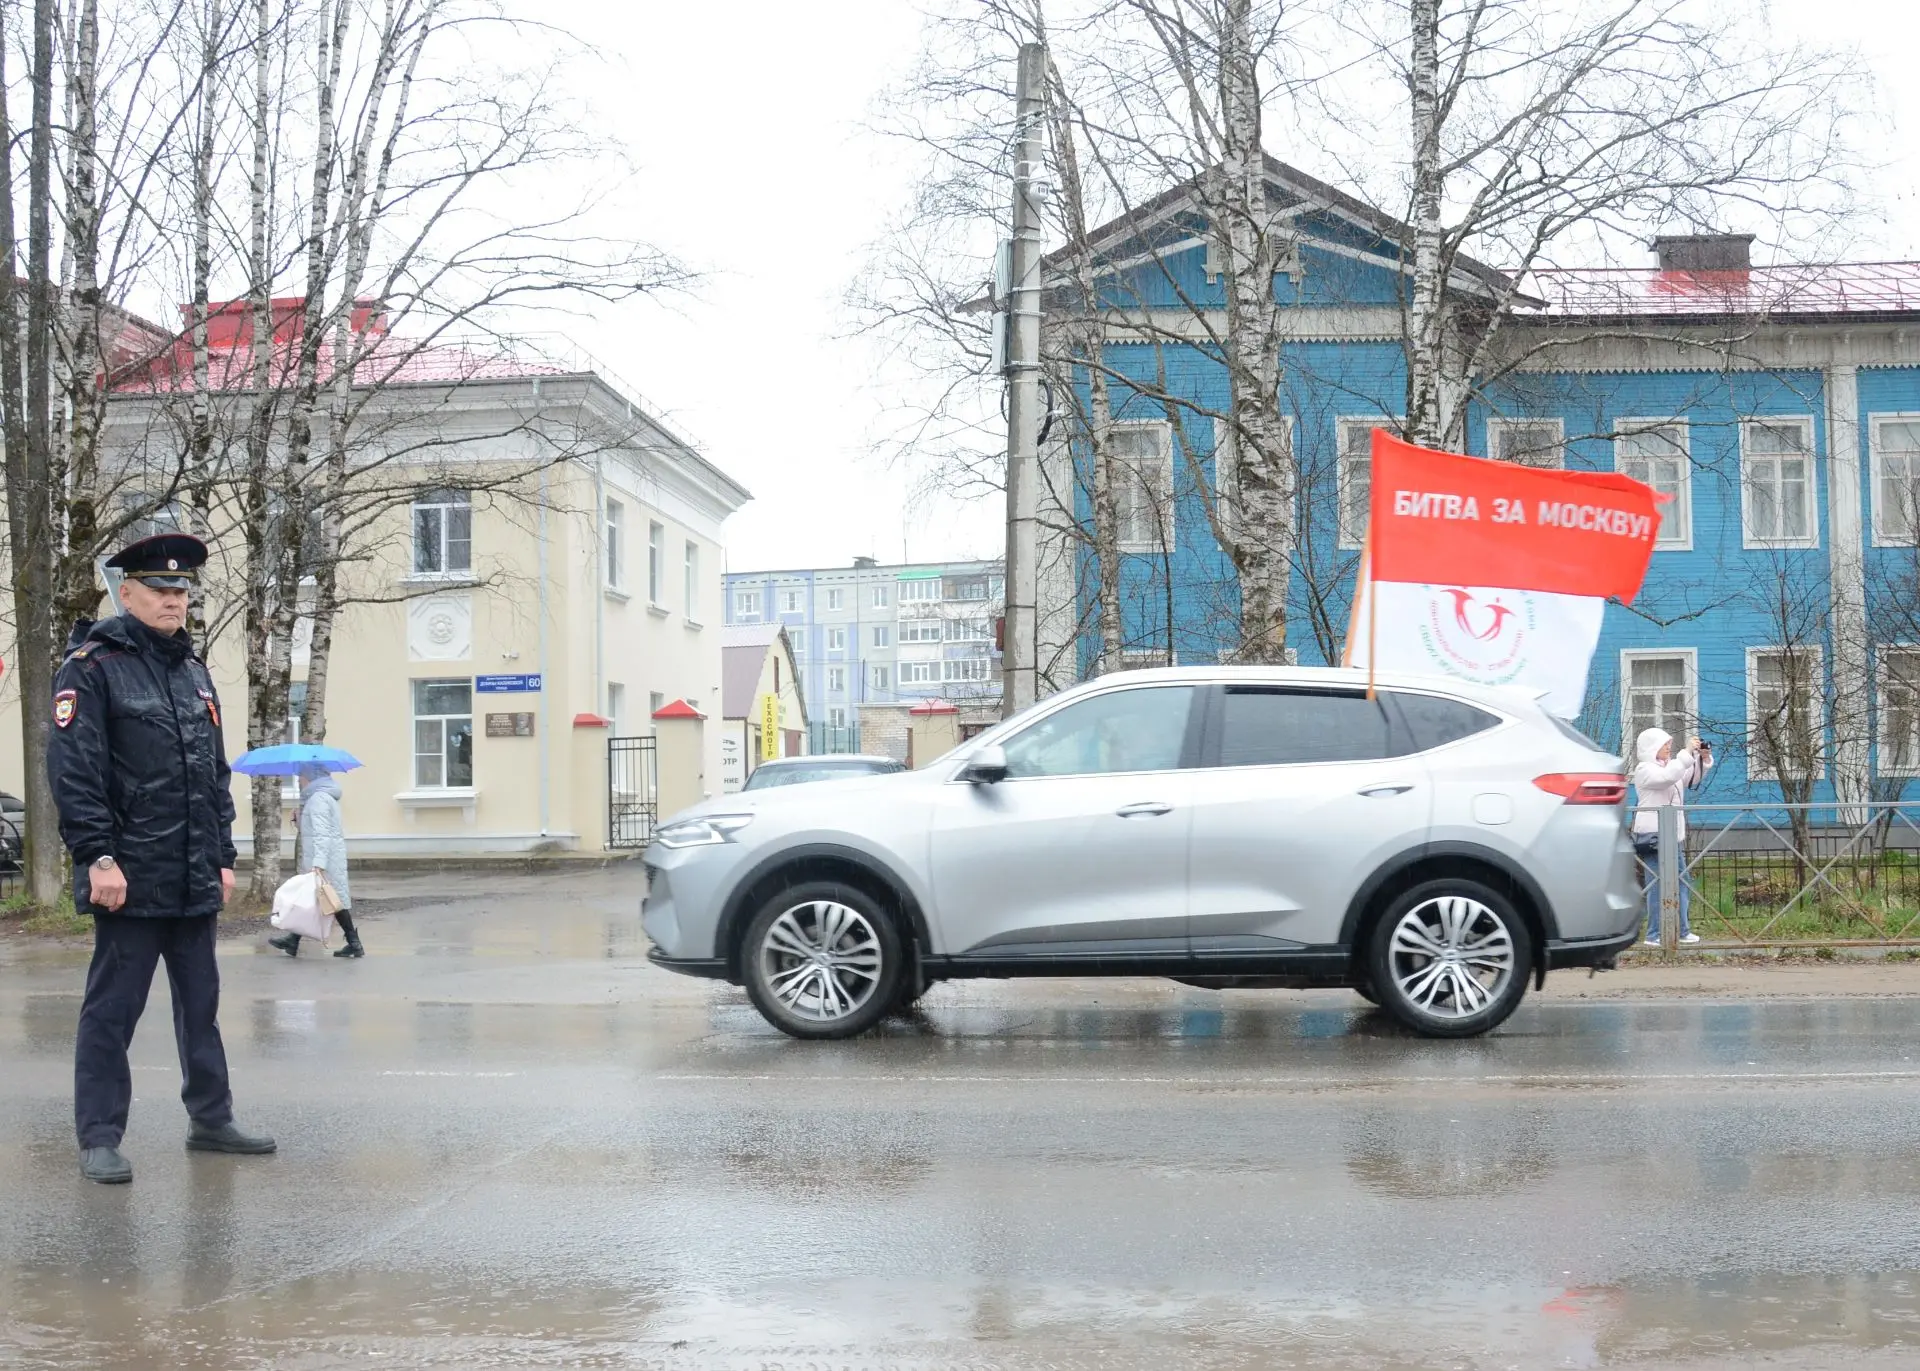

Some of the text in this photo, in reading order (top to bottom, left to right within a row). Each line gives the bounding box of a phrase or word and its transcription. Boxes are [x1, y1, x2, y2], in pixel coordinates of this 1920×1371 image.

[1393, 490, 1651, 541] БИТВА ЗА МОСКВУ!
[528, 677, 541, 688] 60
[766, 696, 774, 757] ТЕХОСМОТР
